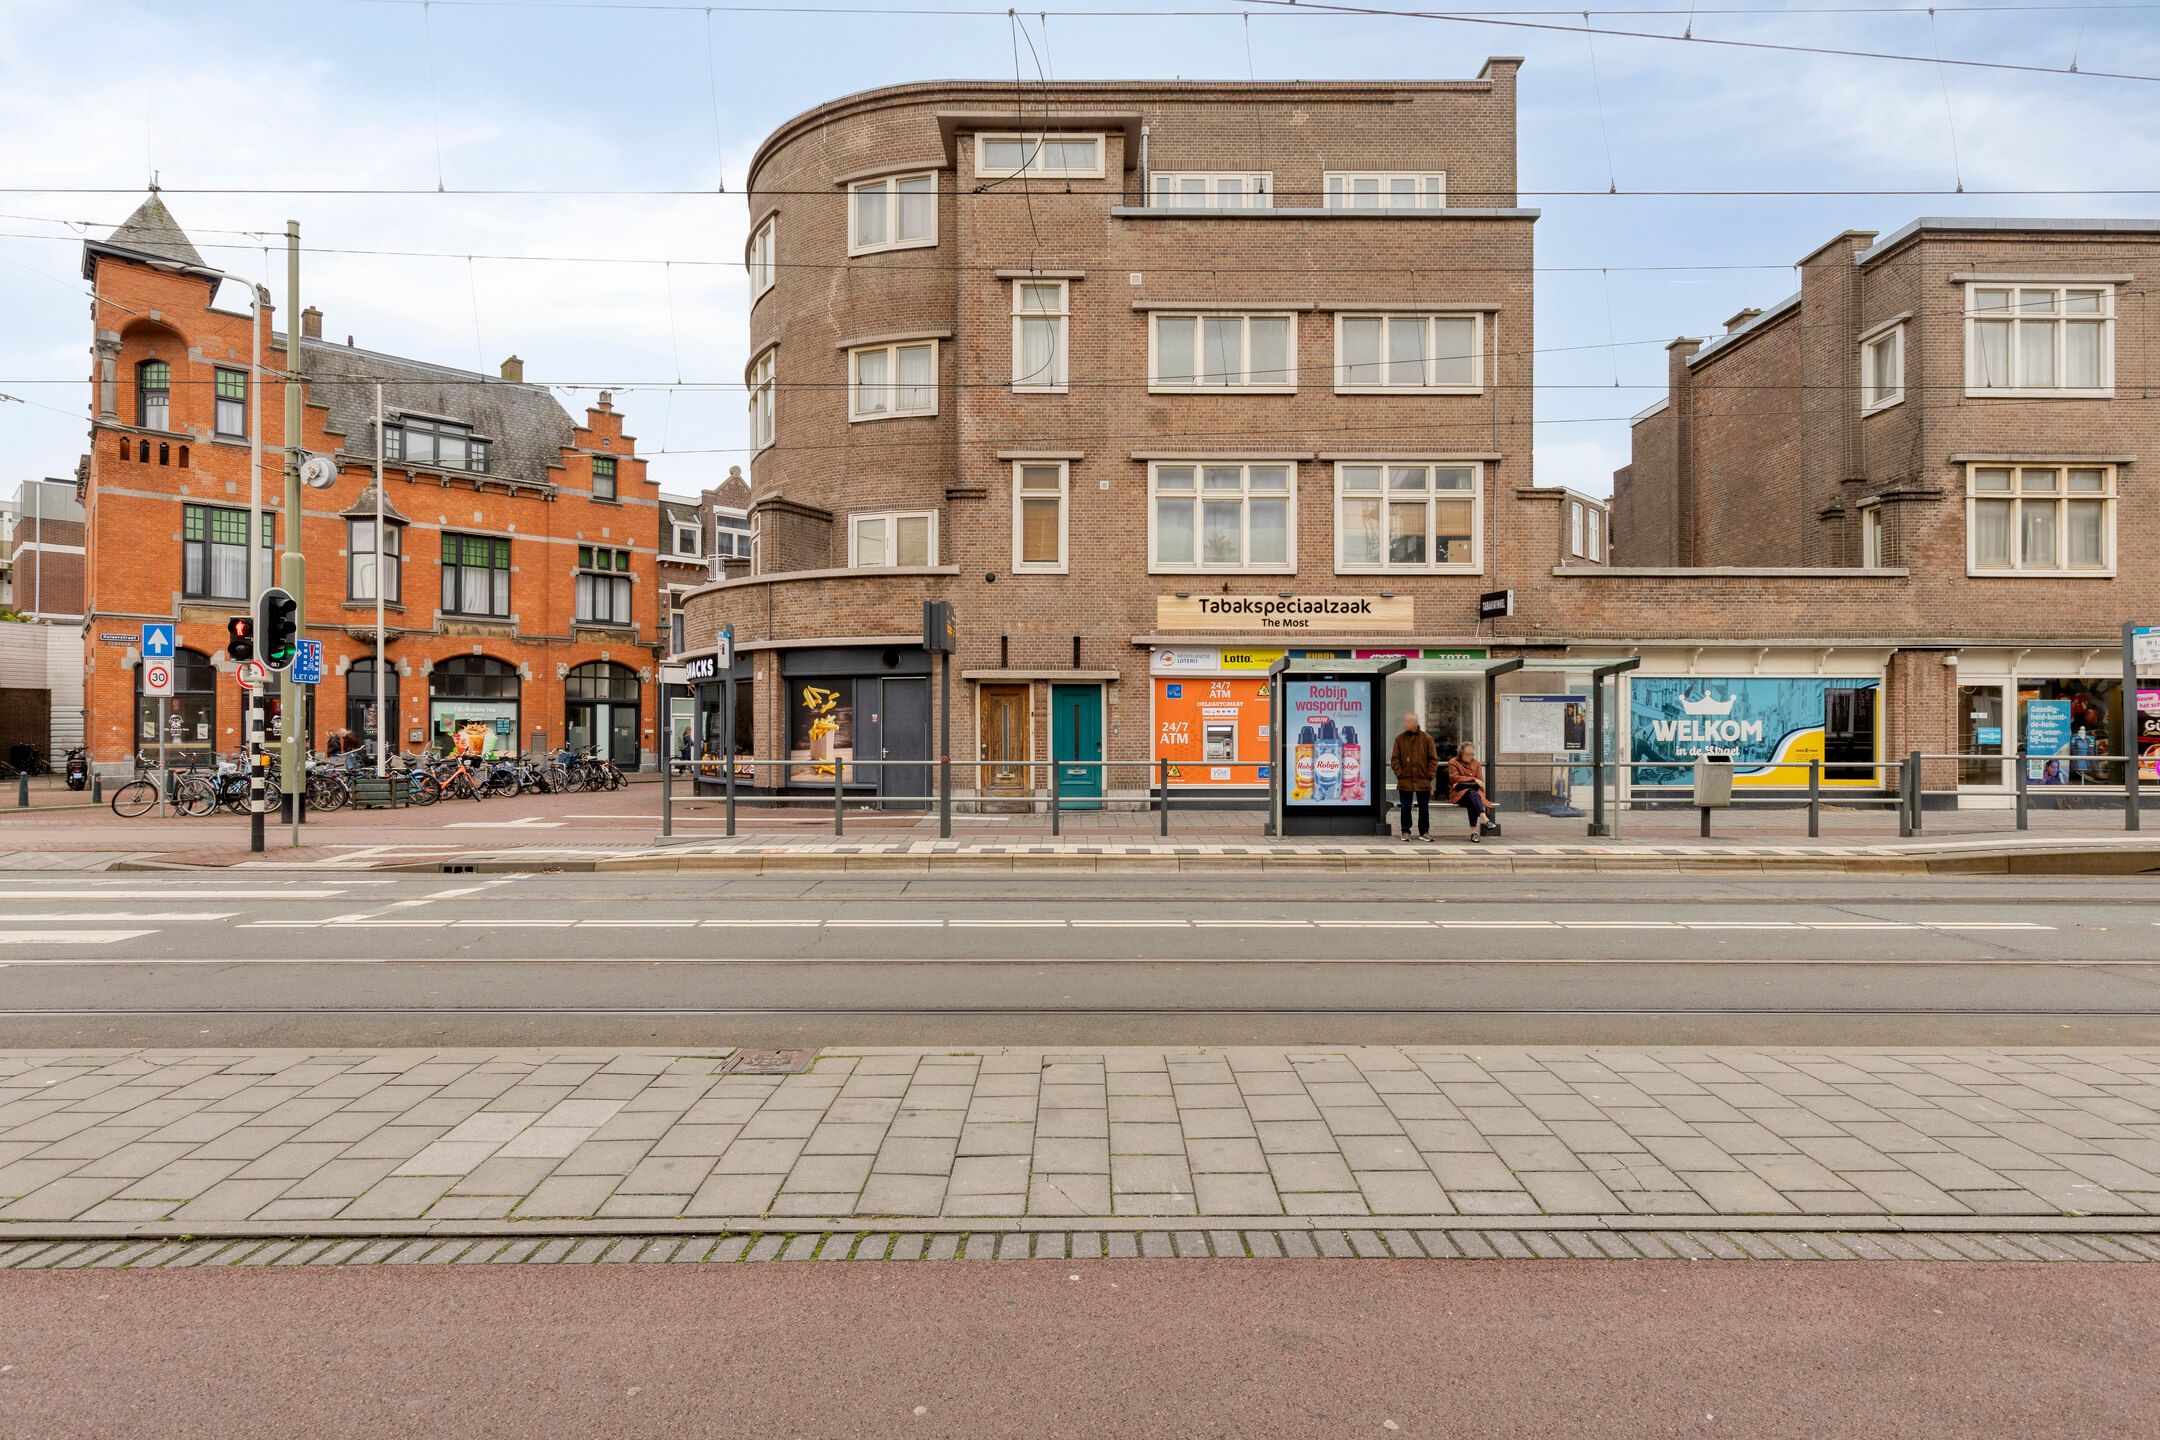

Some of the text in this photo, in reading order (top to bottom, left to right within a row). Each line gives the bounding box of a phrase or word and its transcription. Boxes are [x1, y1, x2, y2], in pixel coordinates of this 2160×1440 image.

[1199, 598, 1371, 616] Tabakspeciaalzaak
[1261, 618, 1309, 627] The Most
[151, 672, 166, 682] 30
[1210, 681, 1231, 690] 24/7
[1209, 690, 1231, 699] ATM
[1309, 685, 1347, 700] Robijn
[1295, 698, 1362, 713] wasparfum
[1161, 722, 1189, 732] 24/7
[1652, 720, 1763, 741] WELKOM
[1160, 733, 1189, 744] ATM
[1676, 745, 1687, 756] in
[1689, 745, 1702, 756] de
[1317, 760, 1339, 769] Robijn
[1341, 762, 1358, 770] obijn
